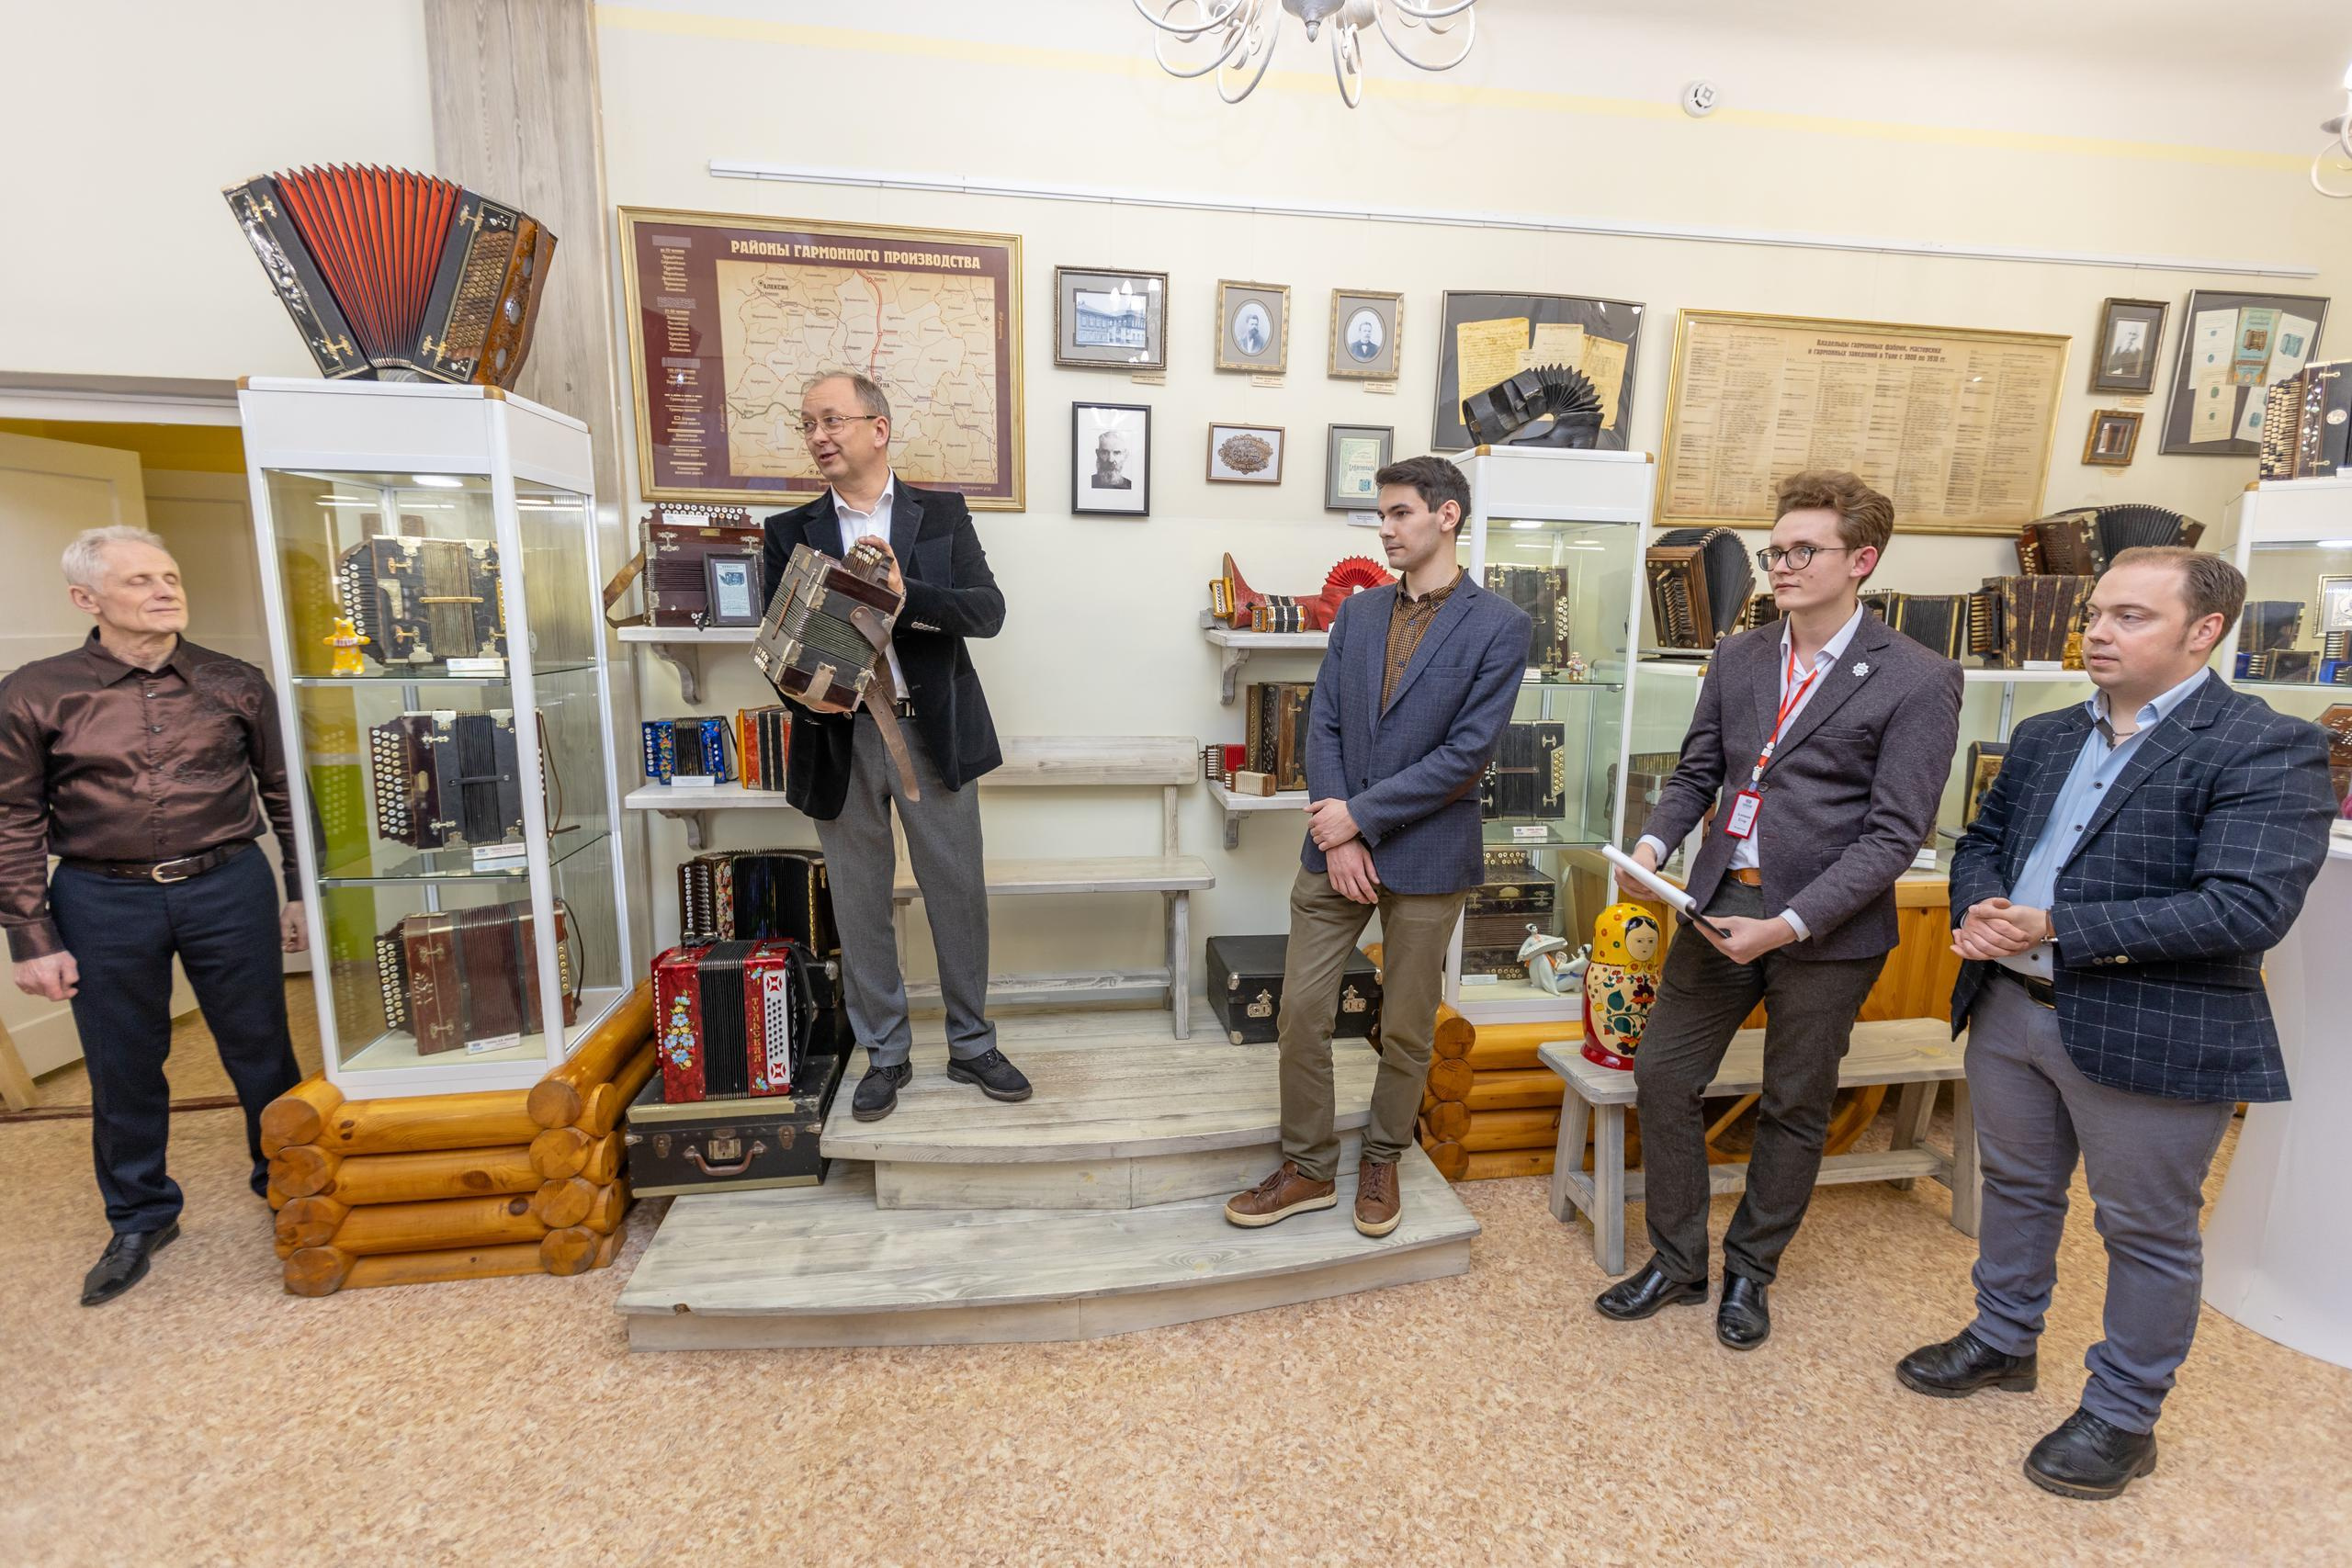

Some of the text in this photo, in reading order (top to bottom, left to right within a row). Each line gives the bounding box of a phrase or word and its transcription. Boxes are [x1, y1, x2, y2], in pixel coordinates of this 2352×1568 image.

[730, 240, 980, 269] РАЙОНЫ ГАРМОННОГО ПРОИЗВОДСТВА
[1814, 348, 1847, 356] гармонных
[1849, 350, 1878, 358] заведений
[752, 997, 762, 1062] ТУЛЬСКАЯ
